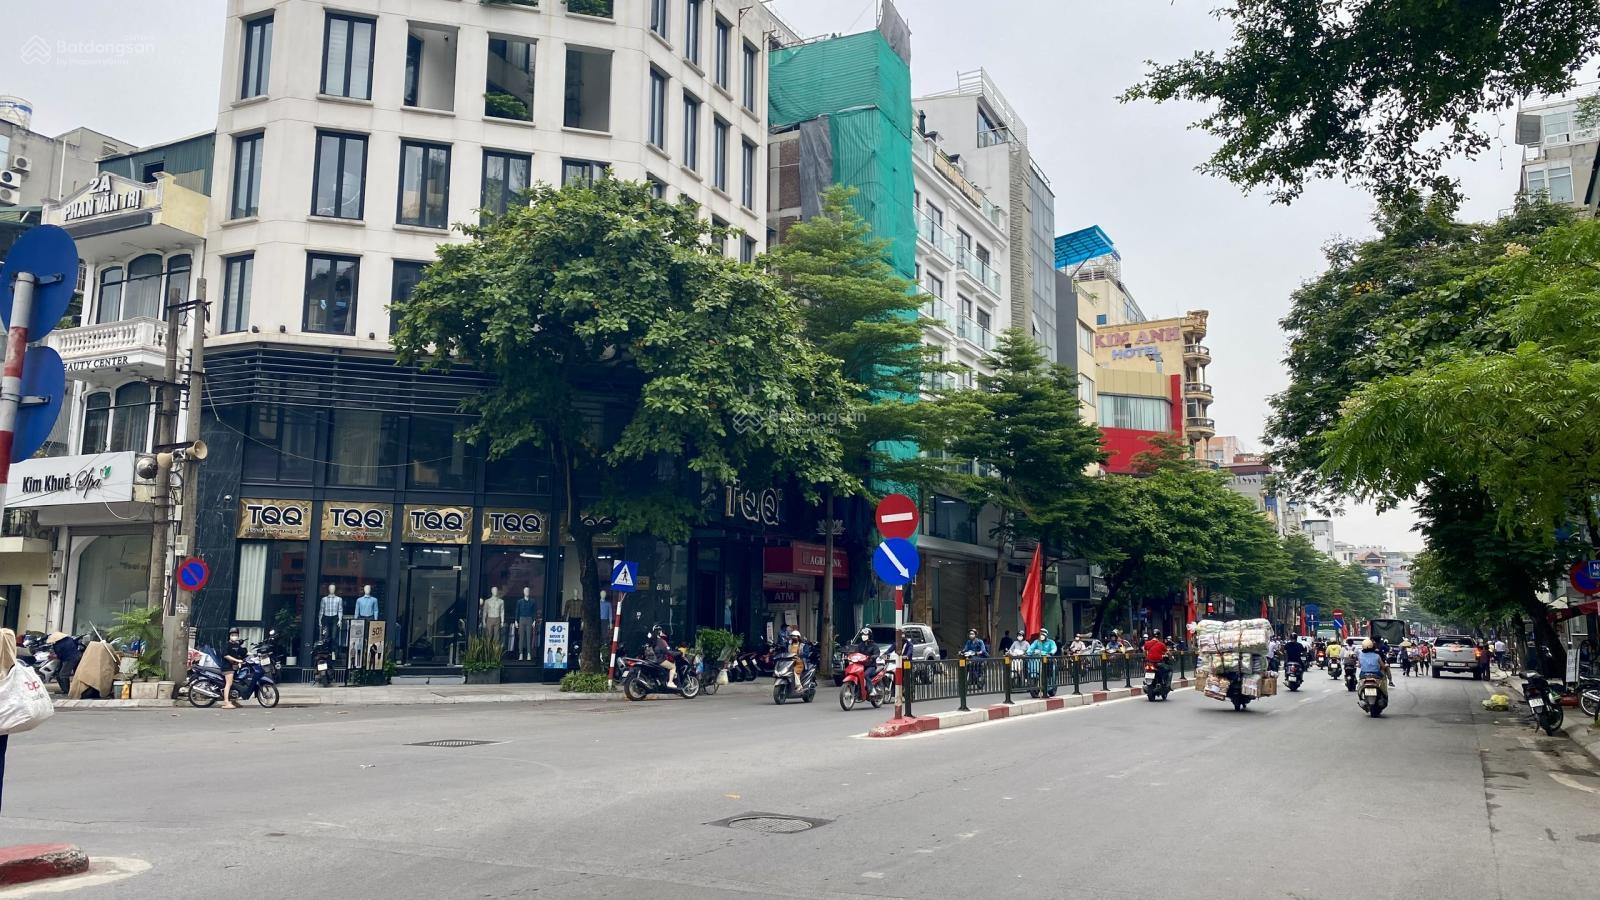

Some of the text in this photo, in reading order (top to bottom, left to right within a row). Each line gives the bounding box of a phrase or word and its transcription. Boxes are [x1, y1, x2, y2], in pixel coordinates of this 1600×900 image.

[89, 175, 111, 194] 2A
[63, 189, 142, 221] PHAN VĂN TRỊ
[1094, 327, 1180, 347] KIM ANH
[1112, 345, 1160, 360] HOTEL
[63, 355, 129, 372] EAUTY CENTER
[22, 466, 102, 499] Kim Khuê Spa
[809, 554, 842, 568] AGRINK
[774, 592, 794, 601] ATM
